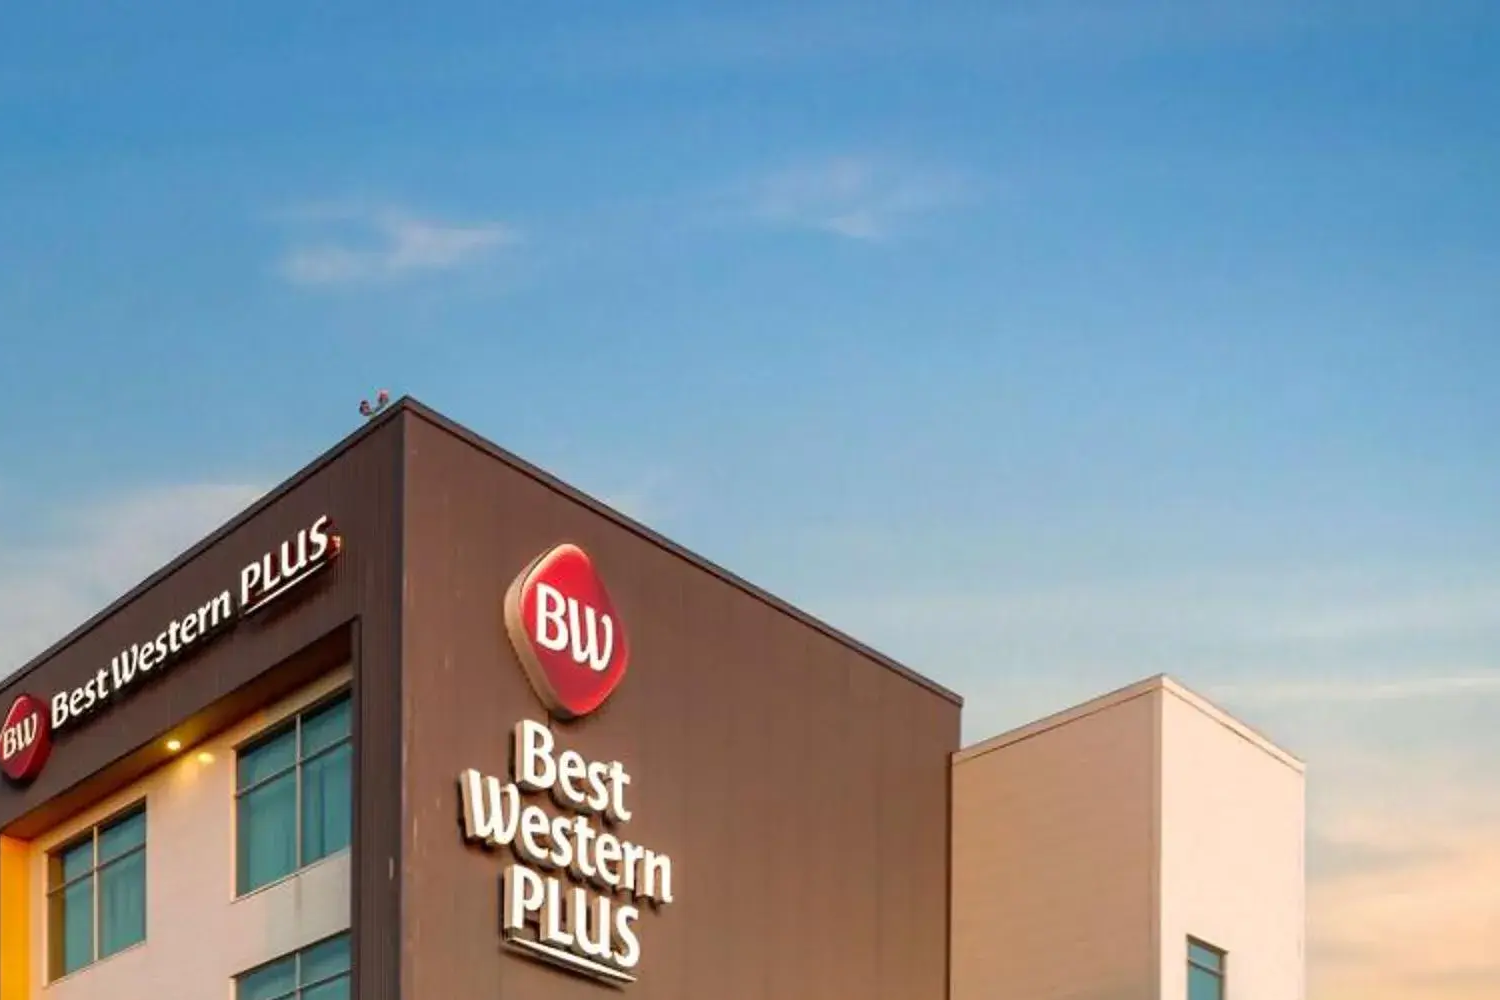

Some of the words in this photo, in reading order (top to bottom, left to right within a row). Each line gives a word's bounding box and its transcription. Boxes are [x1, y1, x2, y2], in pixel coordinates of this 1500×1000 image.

[51, 668, 109, 729] Best
[111, 588, 232, 688] Western
[240, 514, 329, 606] PLUS
[535, 582, 613, 671] BW
[1, 712, 37, 760] BW
[515, 719, 631, 822] Best
[461, 767, 673, 904] Western
[503, 863, 641, 968] PLUS
